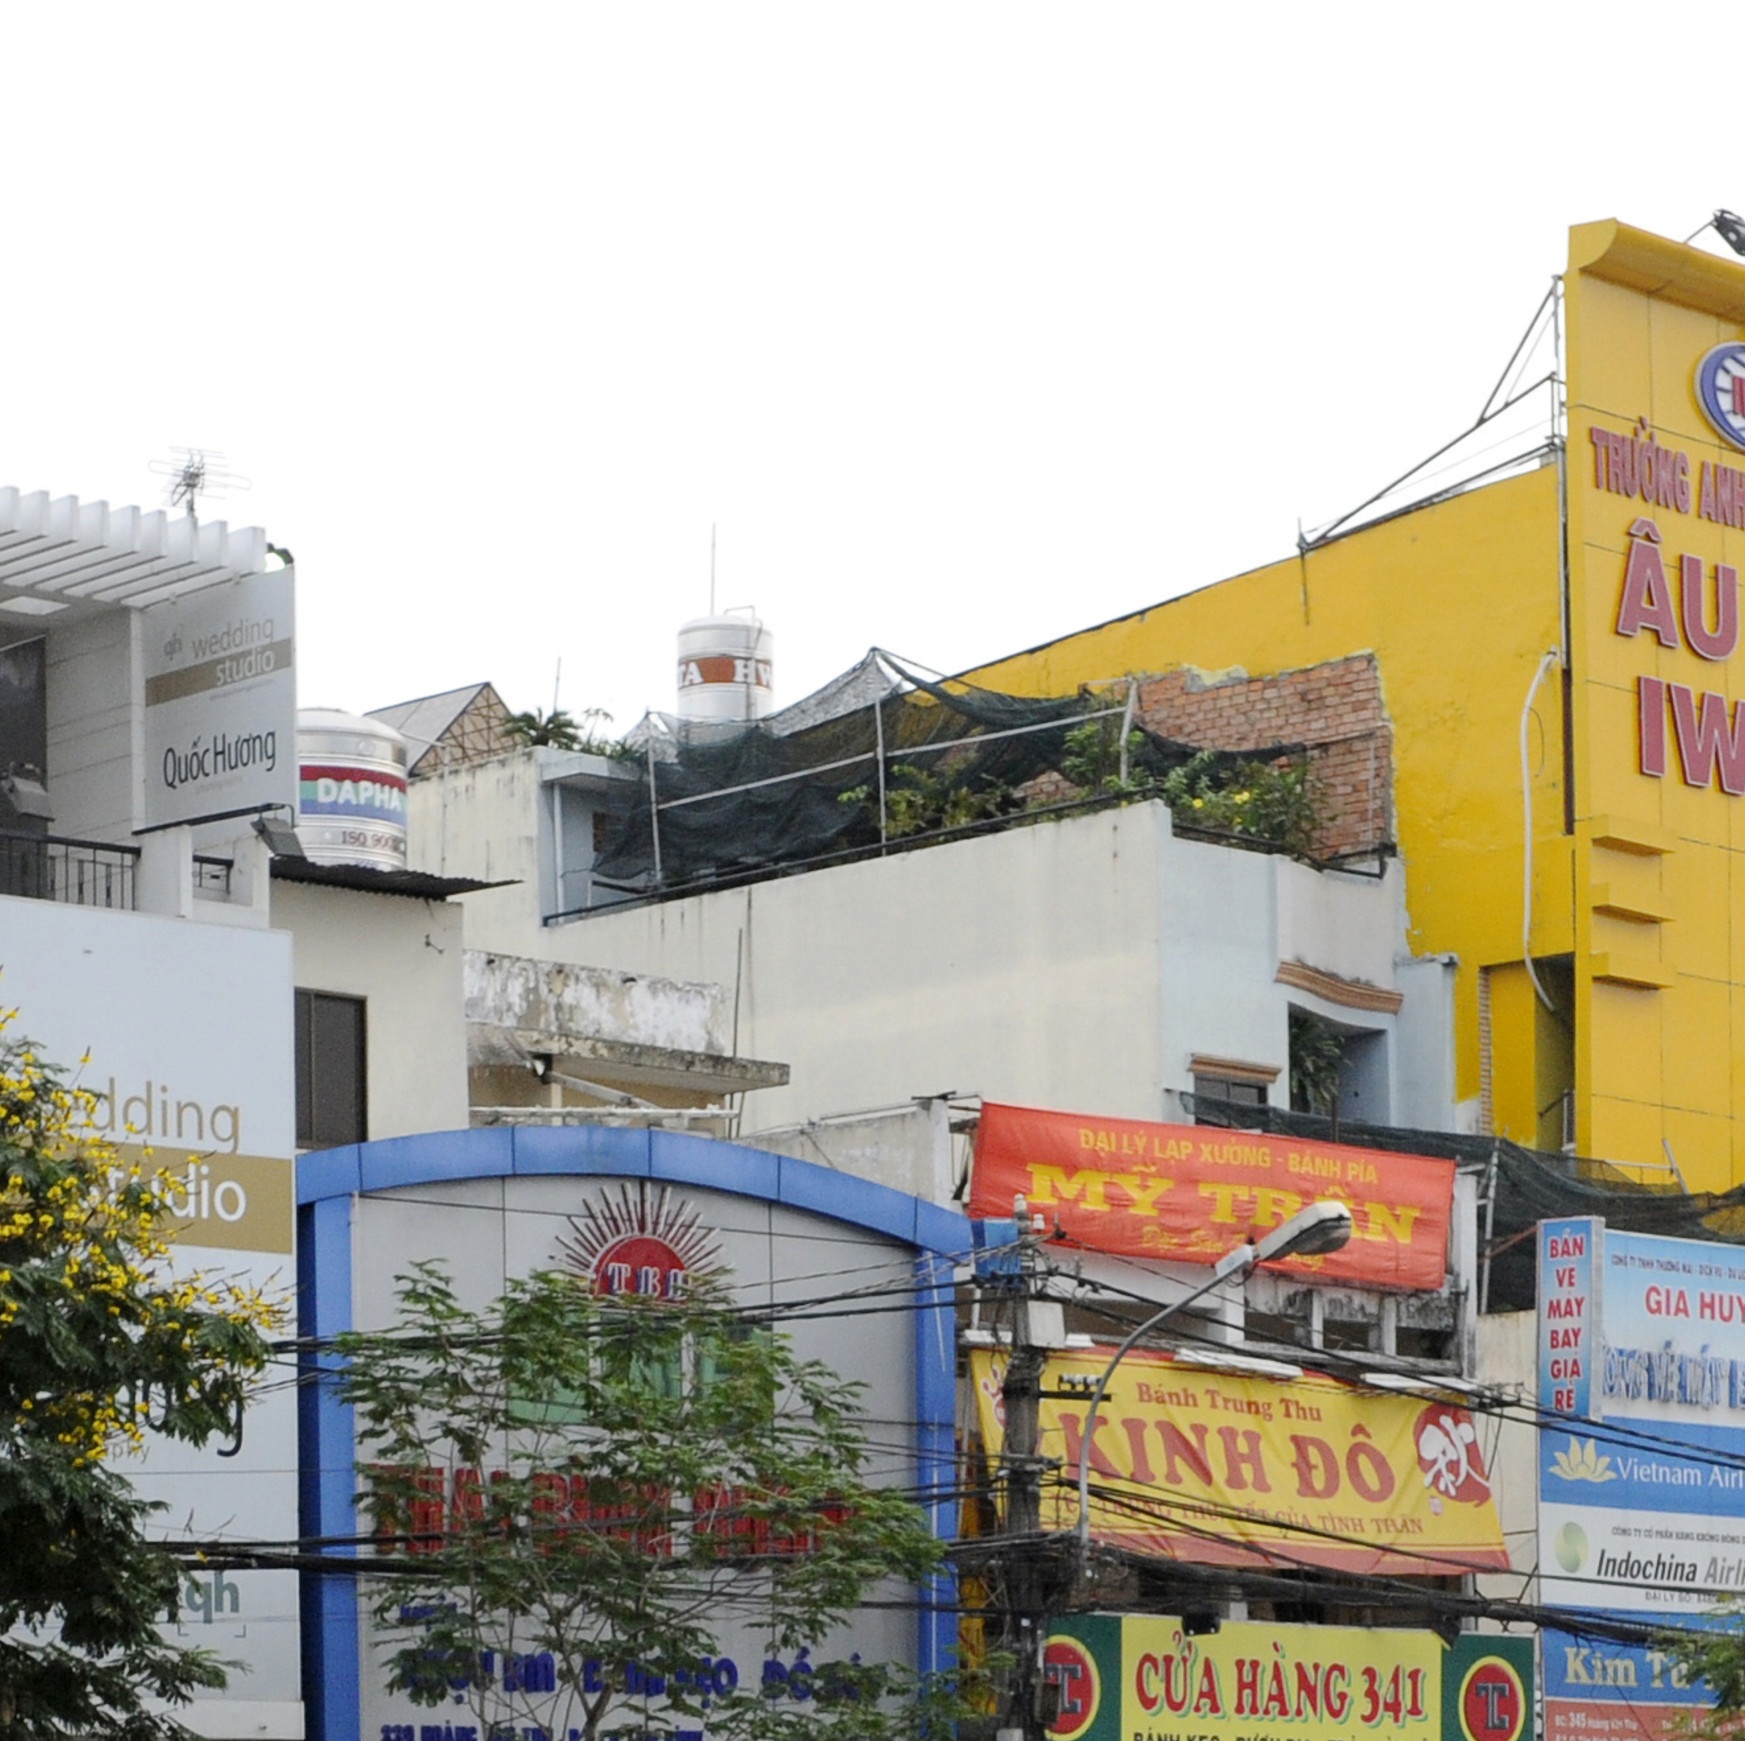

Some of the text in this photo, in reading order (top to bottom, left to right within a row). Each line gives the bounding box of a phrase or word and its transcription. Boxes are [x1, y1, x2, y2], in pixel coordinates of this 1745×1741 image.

[1591, 416, 1690, 514] TRƯỜNG
[1617, 518, 1739, 661] ÂU
[191, 618, 274, 660] wedding
[216, 649, 274, 686] studio
[317, 779, 402, 811] DAPHA
[1079, 1129, 1116, 1156] ĐẠI
[1123, 1130, 1146, 1153] LÝ
[1154, 1138, 1193, 1164] LẠP
[1026, 1161, 1175, 1217] MỸ
[1549, 1229, 1585, 1259] BÁN
[1546, 1291, 1585, 1320] MÁY
[1645, 1284, 1690, 1318] GIA
[1550, 1328, 1582, 1349] BAY
[1137, 1382, 1322, 1422] Bánh Trung Thu
[1058, 1412, 1396, 1504] KINH ĐÔ
[1616, 1457, 1703, 1486] Vietnam
[1317, 1509, 1366, 1535] TÌNH
[1597, 1549, 1697, 1582] Indochina
[1136, 1631, 1426, 1725] CỬA HÀNG 341
[1564, 1647, 1637, 1686] Kim
